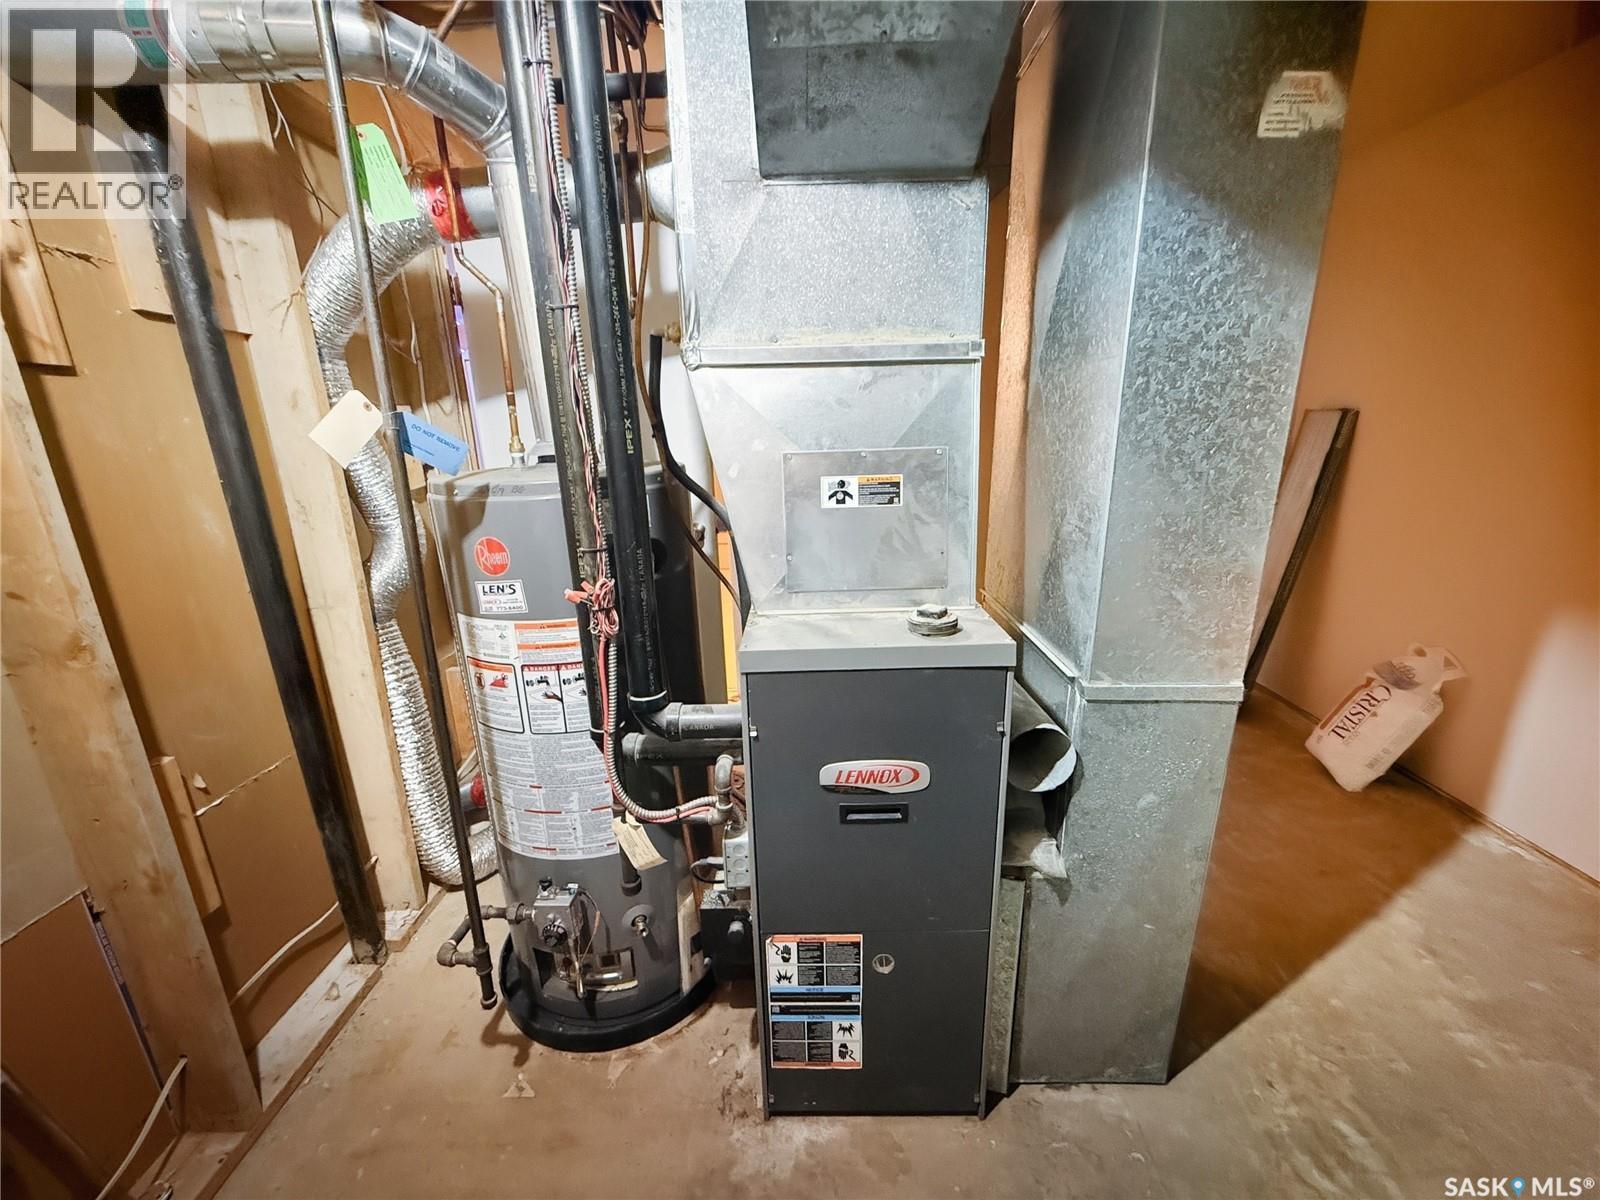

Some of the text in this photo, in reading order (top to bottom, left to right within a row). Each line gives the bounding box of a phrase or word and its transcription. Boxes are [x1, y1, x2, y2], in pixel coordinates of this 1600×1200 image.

[411, 423, 422, 432] DO
[422, 430, 436, 438] NOT
[624, 418, 634, 454] IPEX
[477, 540, 508, 570] Rheem
[482, 584, 516, 595] LEN'S
[1328, 685, 1391, 739] CRISTAL
[835, 769, 902, 784] LENNOX
